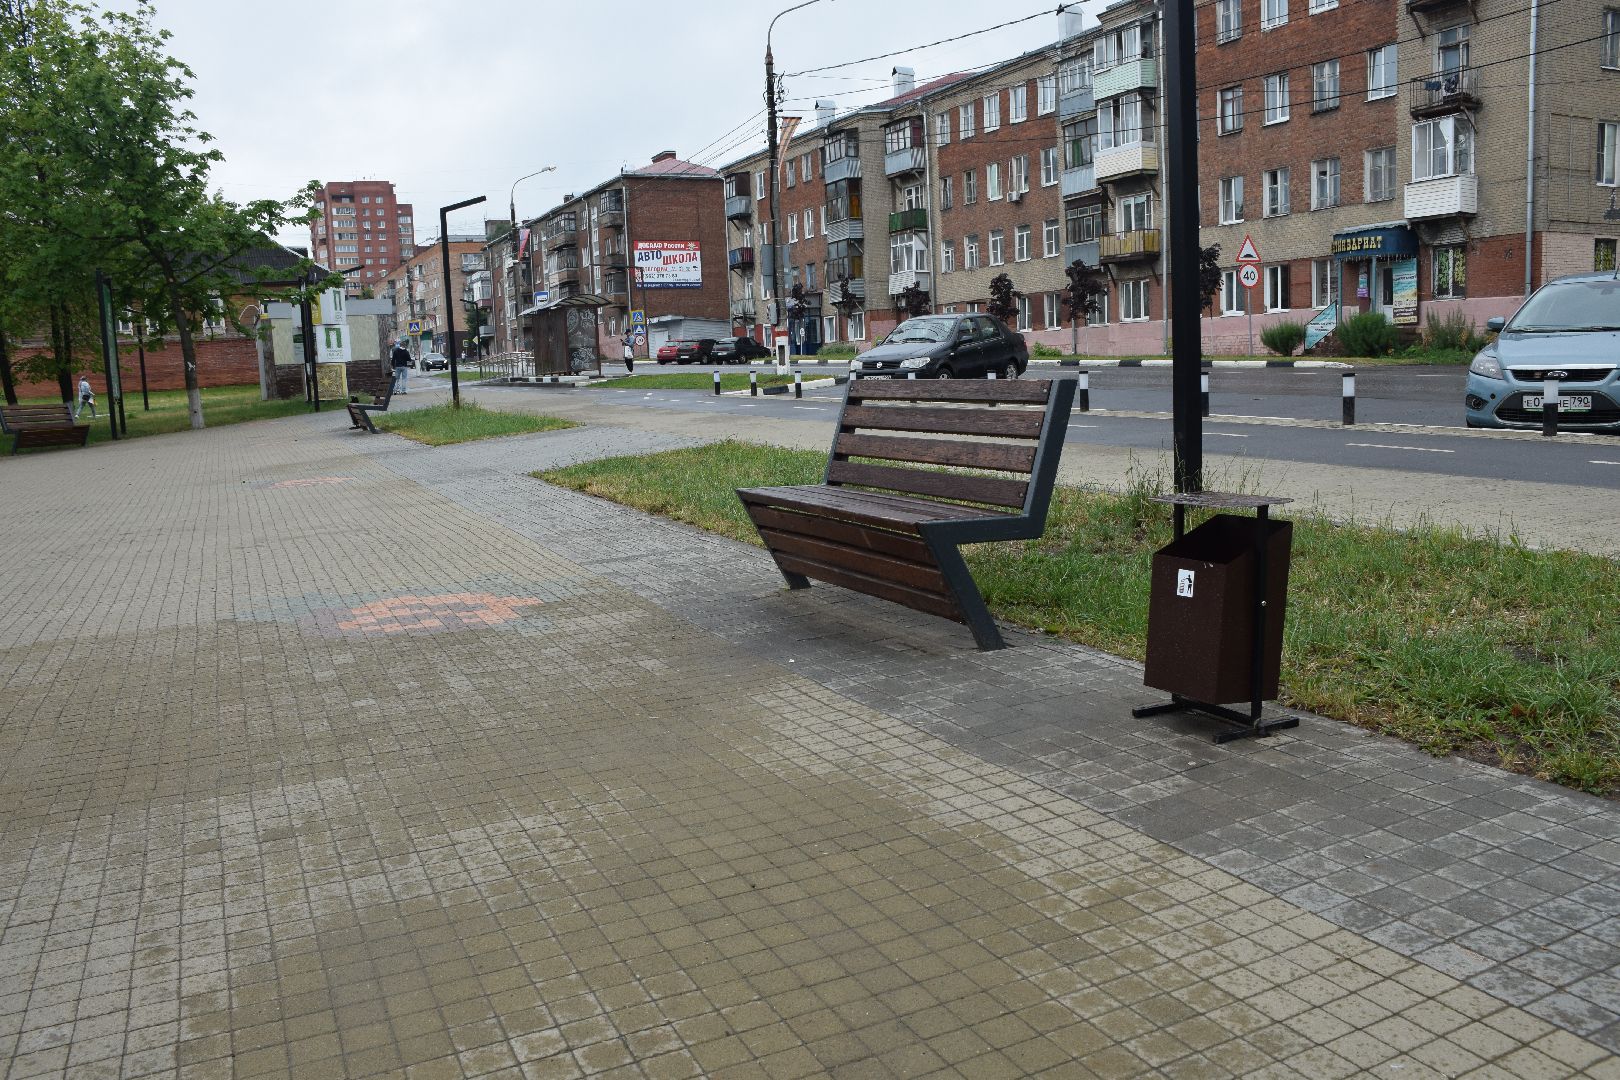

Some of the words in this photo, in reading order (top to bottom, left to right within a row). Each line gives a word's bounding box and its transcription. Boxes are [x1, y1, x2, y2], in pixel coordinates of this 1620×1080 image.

[638, 250, 662, 262] АВТО
[662, 252, 697, 265] ШКОЛА
[1243, 271, 1255, 280] 40
